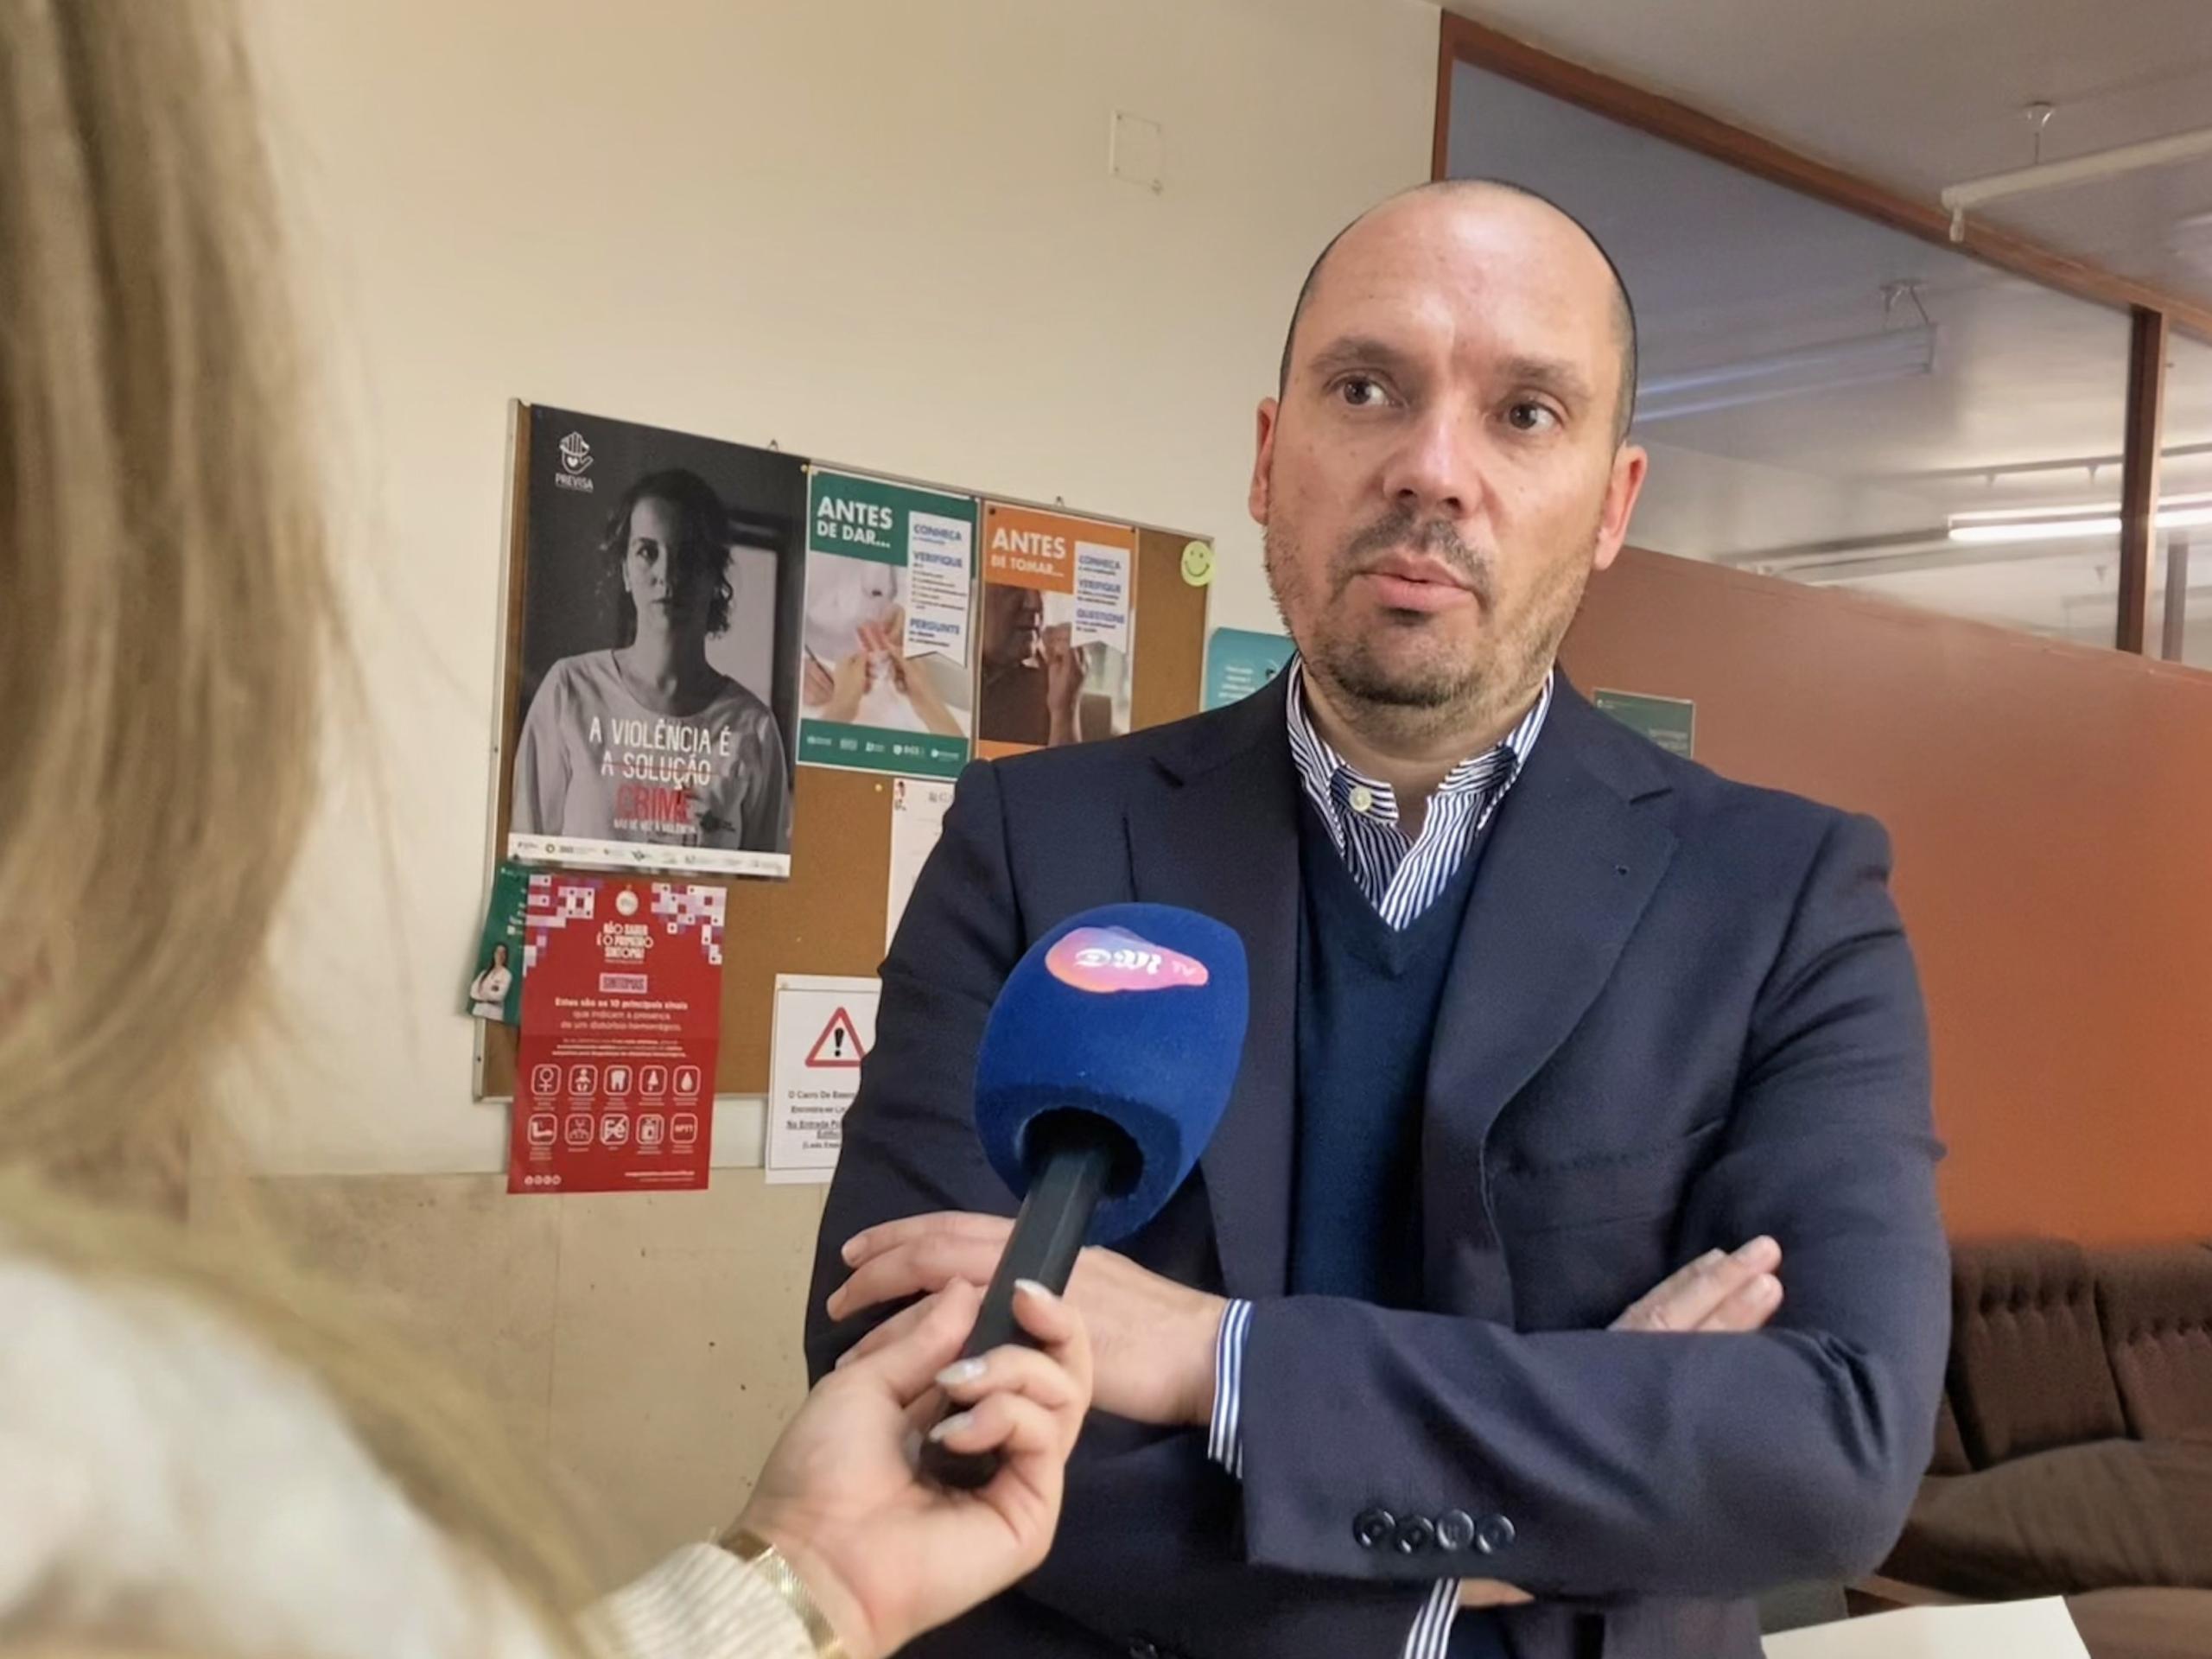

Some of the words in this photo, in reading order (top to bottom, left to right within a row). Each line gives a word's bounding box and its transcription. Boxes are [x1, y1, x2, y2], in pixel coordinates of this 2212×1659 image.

[556, 473, 594, 492] PREVISA
[817, 495, 893, 531] ANTES
[817, 519, 838, 539] DE
[842, 524, 892, 549] DAR...
[991, 526, 1067, 560] ANTES
[912, 550, 963, 569] VERIFIQUE
[991, 554, 1007, 569] DE
[1078, 579, 1122, 594] VERIFIQUE
[910, 617, 960, 636] PERGUNTE
[589, 715, 603, 744] A
[611, 718, 712, 755] VIOLÊNCIA
[720, 725, 732, 758] É
[601, 749, 615, 778] A
[621, 751, 712, 791] SOLUÇÃO
[617, 783, 695, 825] CRIME
